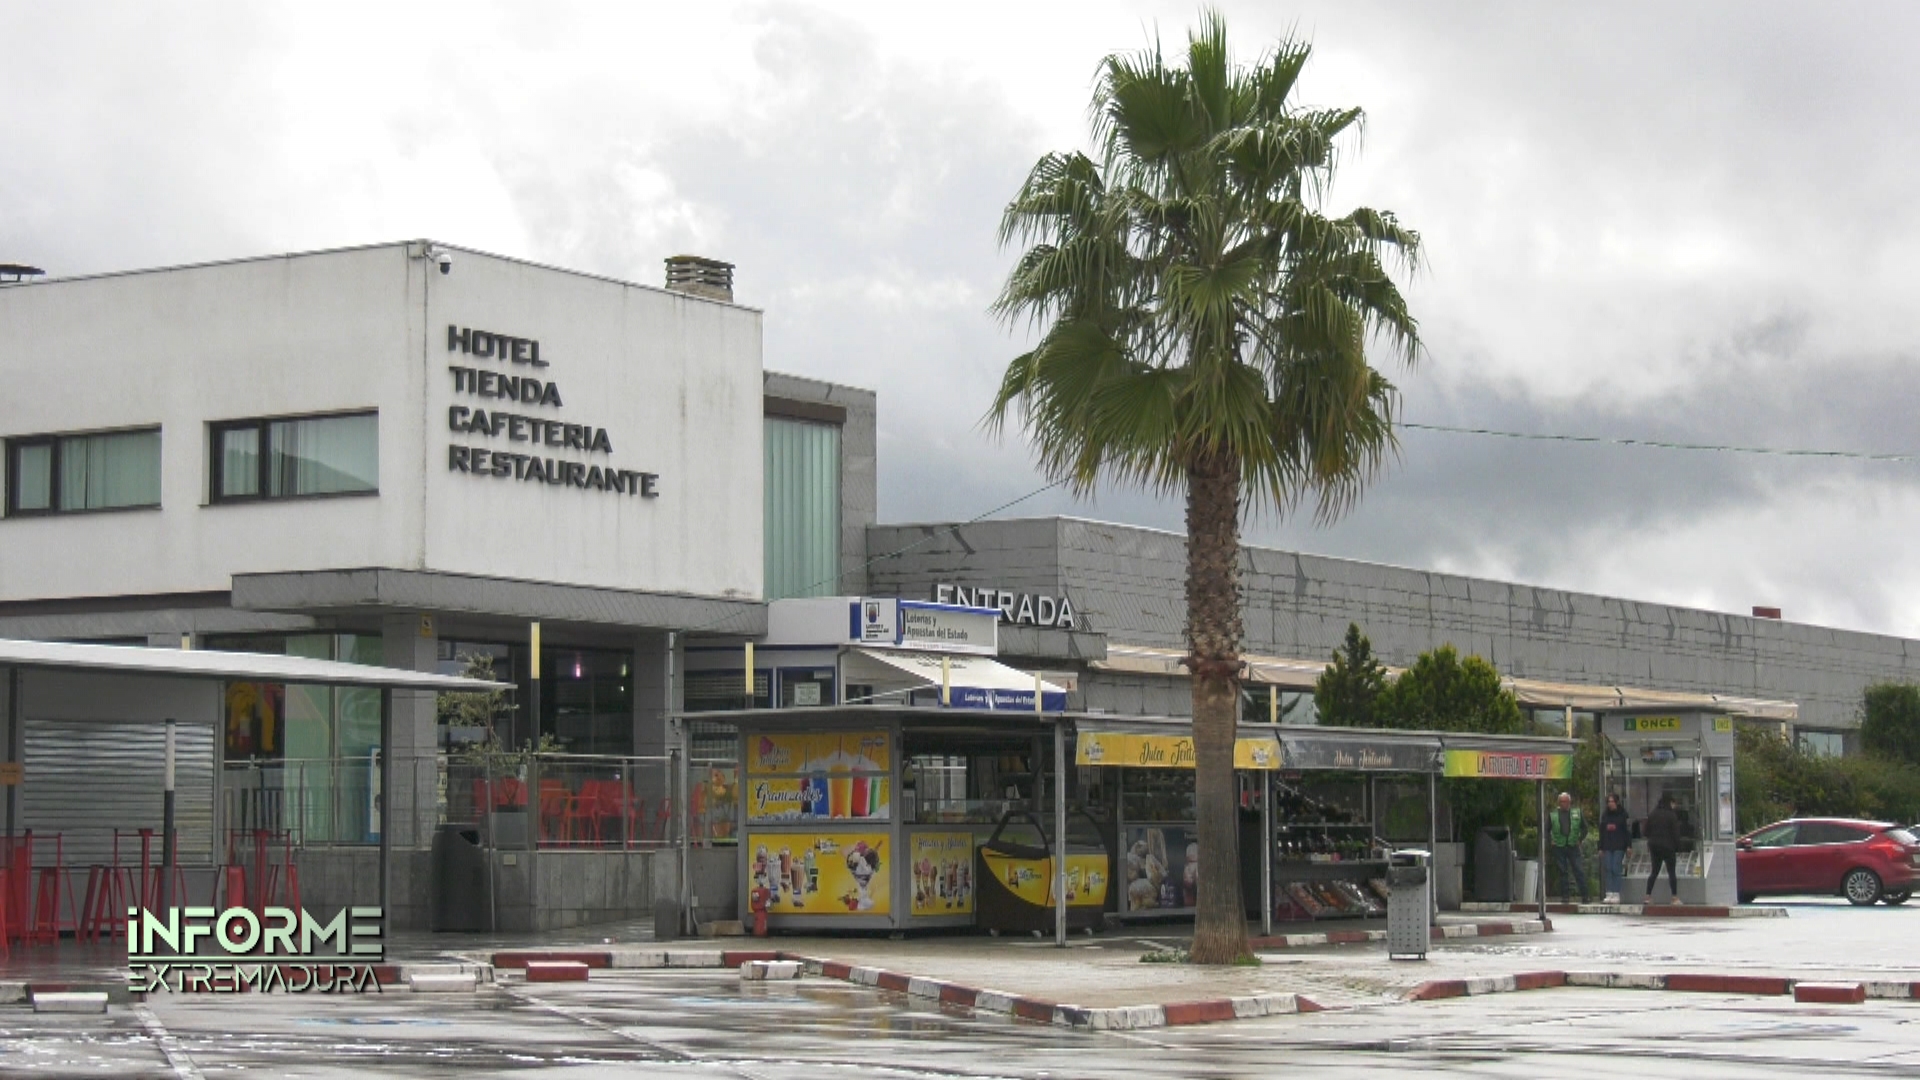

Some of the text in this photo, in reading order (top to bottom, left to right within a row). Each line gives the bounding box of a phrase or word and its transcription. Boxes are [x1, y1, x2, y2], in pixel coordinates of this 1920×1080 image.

[448, 324, 550, 367] HOTEL
[448, 366, 563, 407] TIENDA
[448, 405, 613, 453] CAFETERIA
[448, 444, 660, 498] RESTAURANTE
[932, 616, 937, 627] y
[933, 583, 1076, 629] ENTRADA
[907, 626, 968, 640] Apuestas del Estado
[1640, 718, 1675, 729] ONCE
[1139, 741, 1164, 764] Dulce
[1477, 755, 1487, 773] LA
